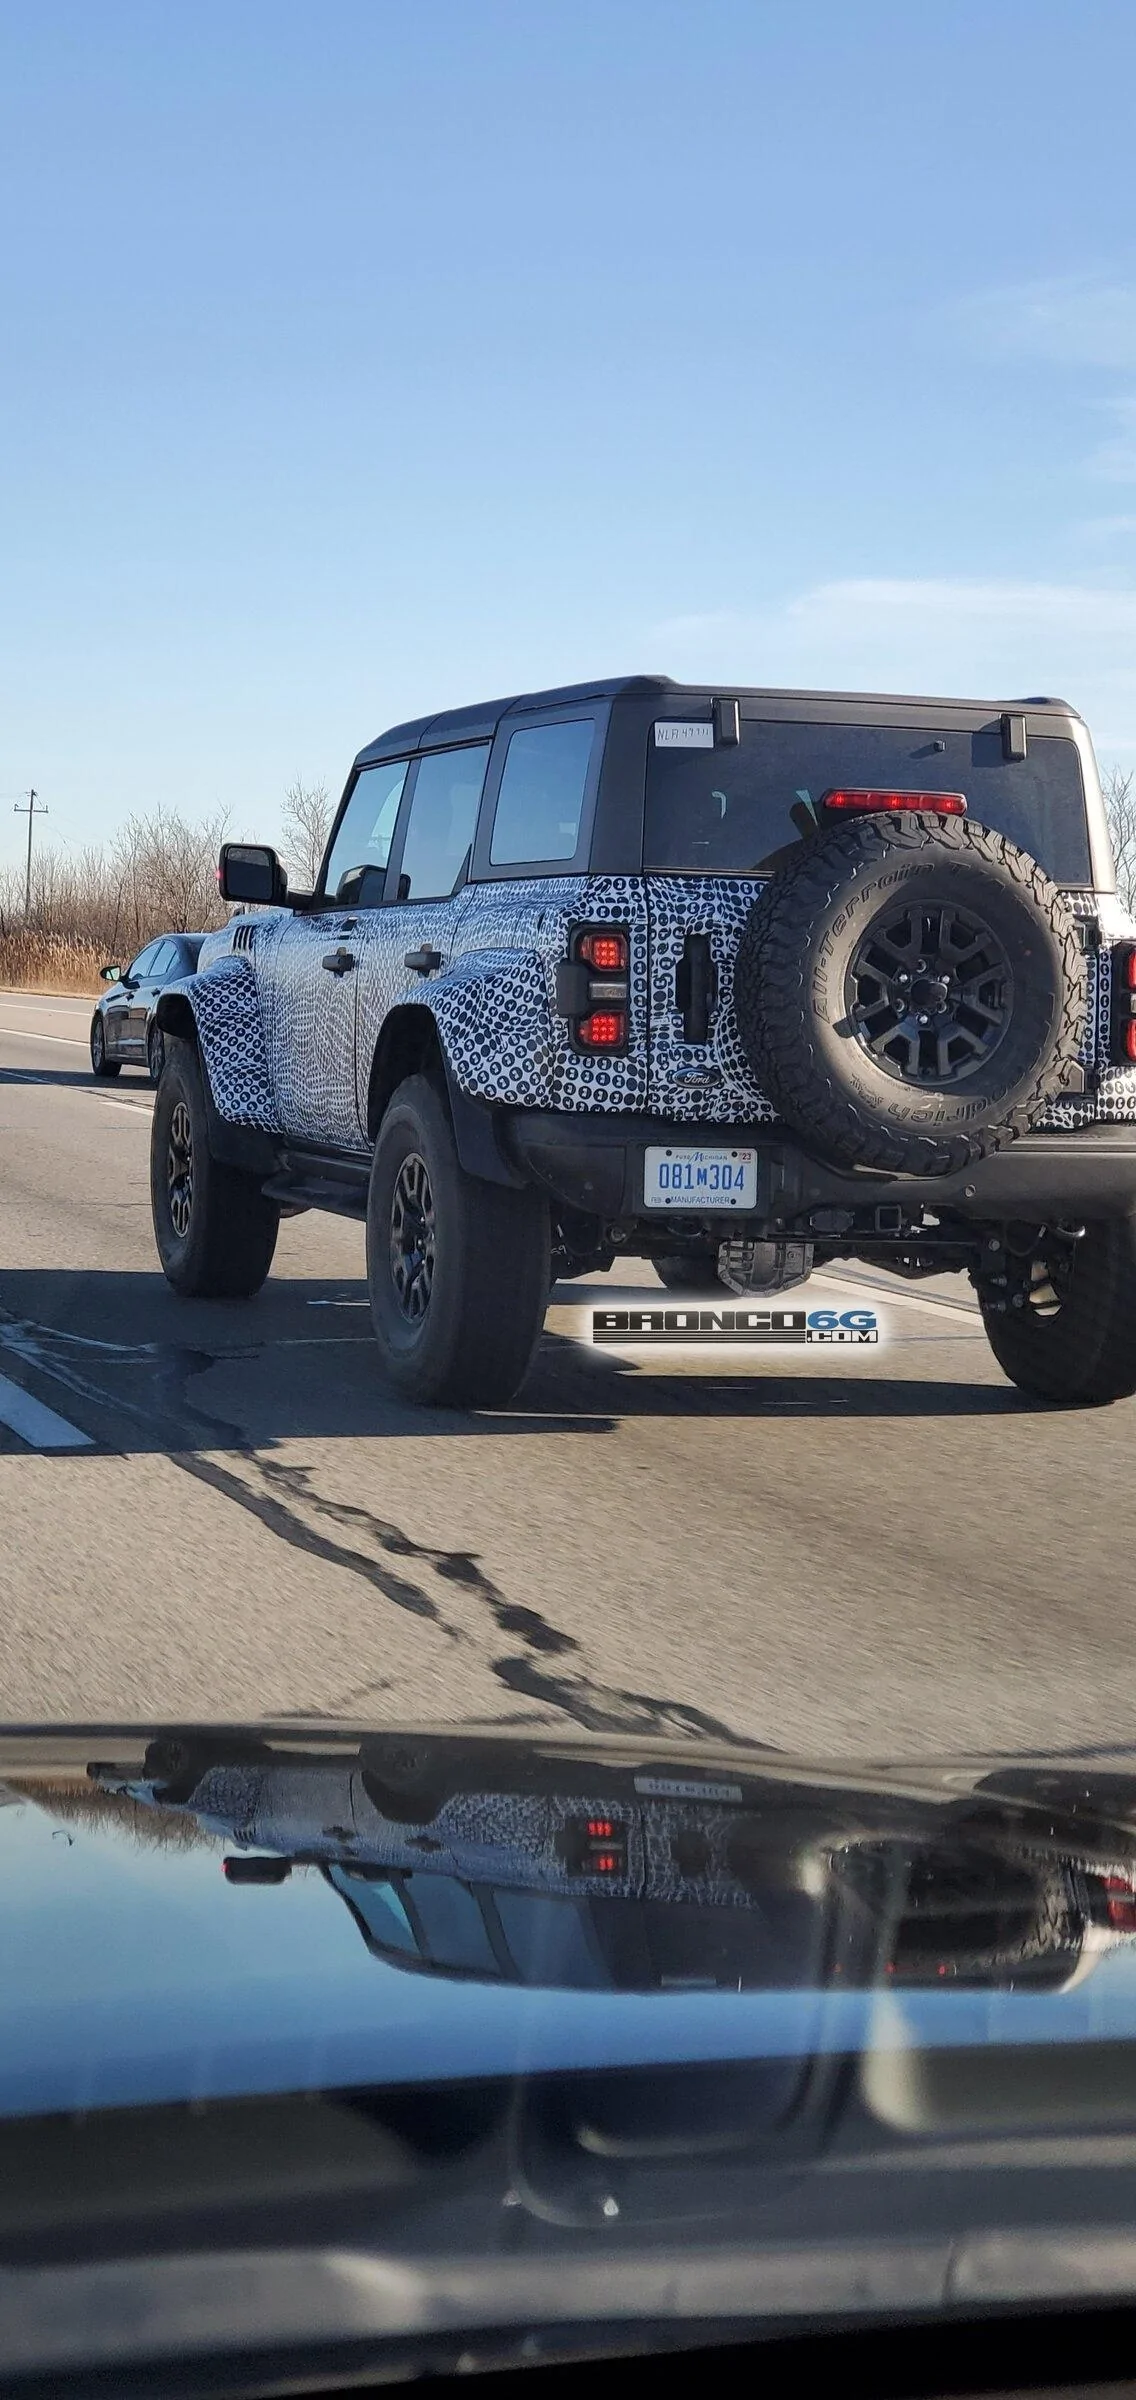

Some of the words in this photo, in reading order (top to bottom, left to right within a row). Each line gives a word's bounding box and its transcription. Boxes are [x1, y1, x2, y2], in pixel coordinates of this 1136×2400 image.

[813, 862, 936, 1025] All-Terrain
[684, 1071, 710, 1084] Ford
[742, 1152, 752, 1160] 23
[659, 1163, 745, 1191] 081M304
[670, 1196, 731, 1205] MANUFACTURER
